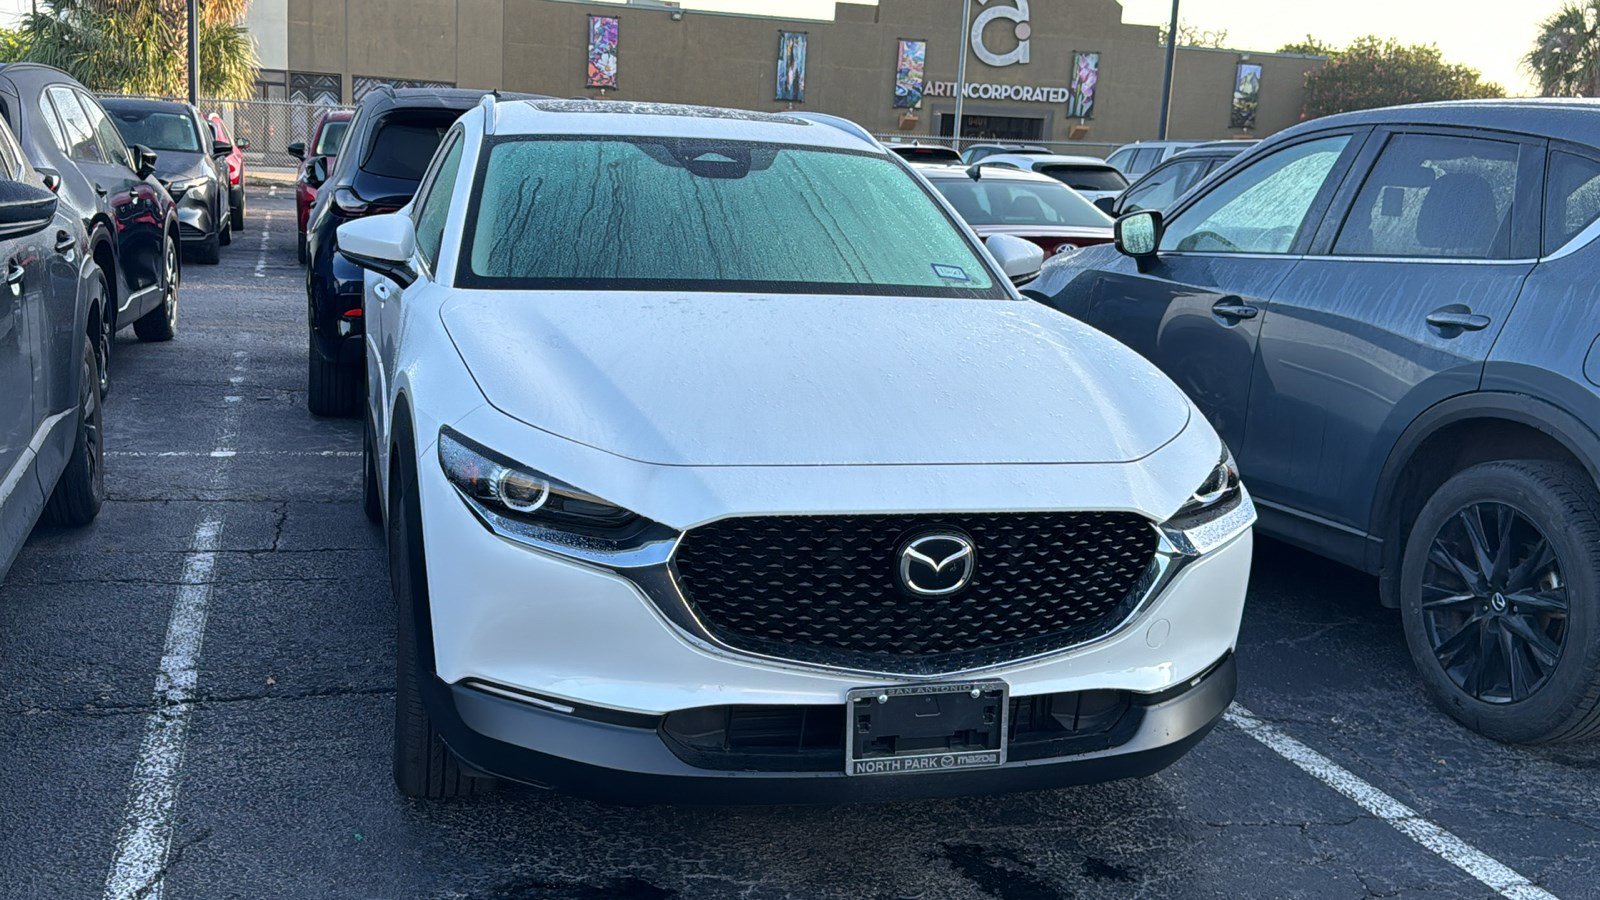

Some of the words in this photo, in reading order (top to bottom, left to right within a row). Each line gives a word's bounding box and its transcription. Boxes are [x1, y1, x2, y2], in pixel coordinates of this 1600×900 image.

[916, 685, 971, 694] ANTONIO
[856, 760, 900, 774] NORTH
[904, 757, 938, 770] PARK
[957, 753, 997, 765] mazda
